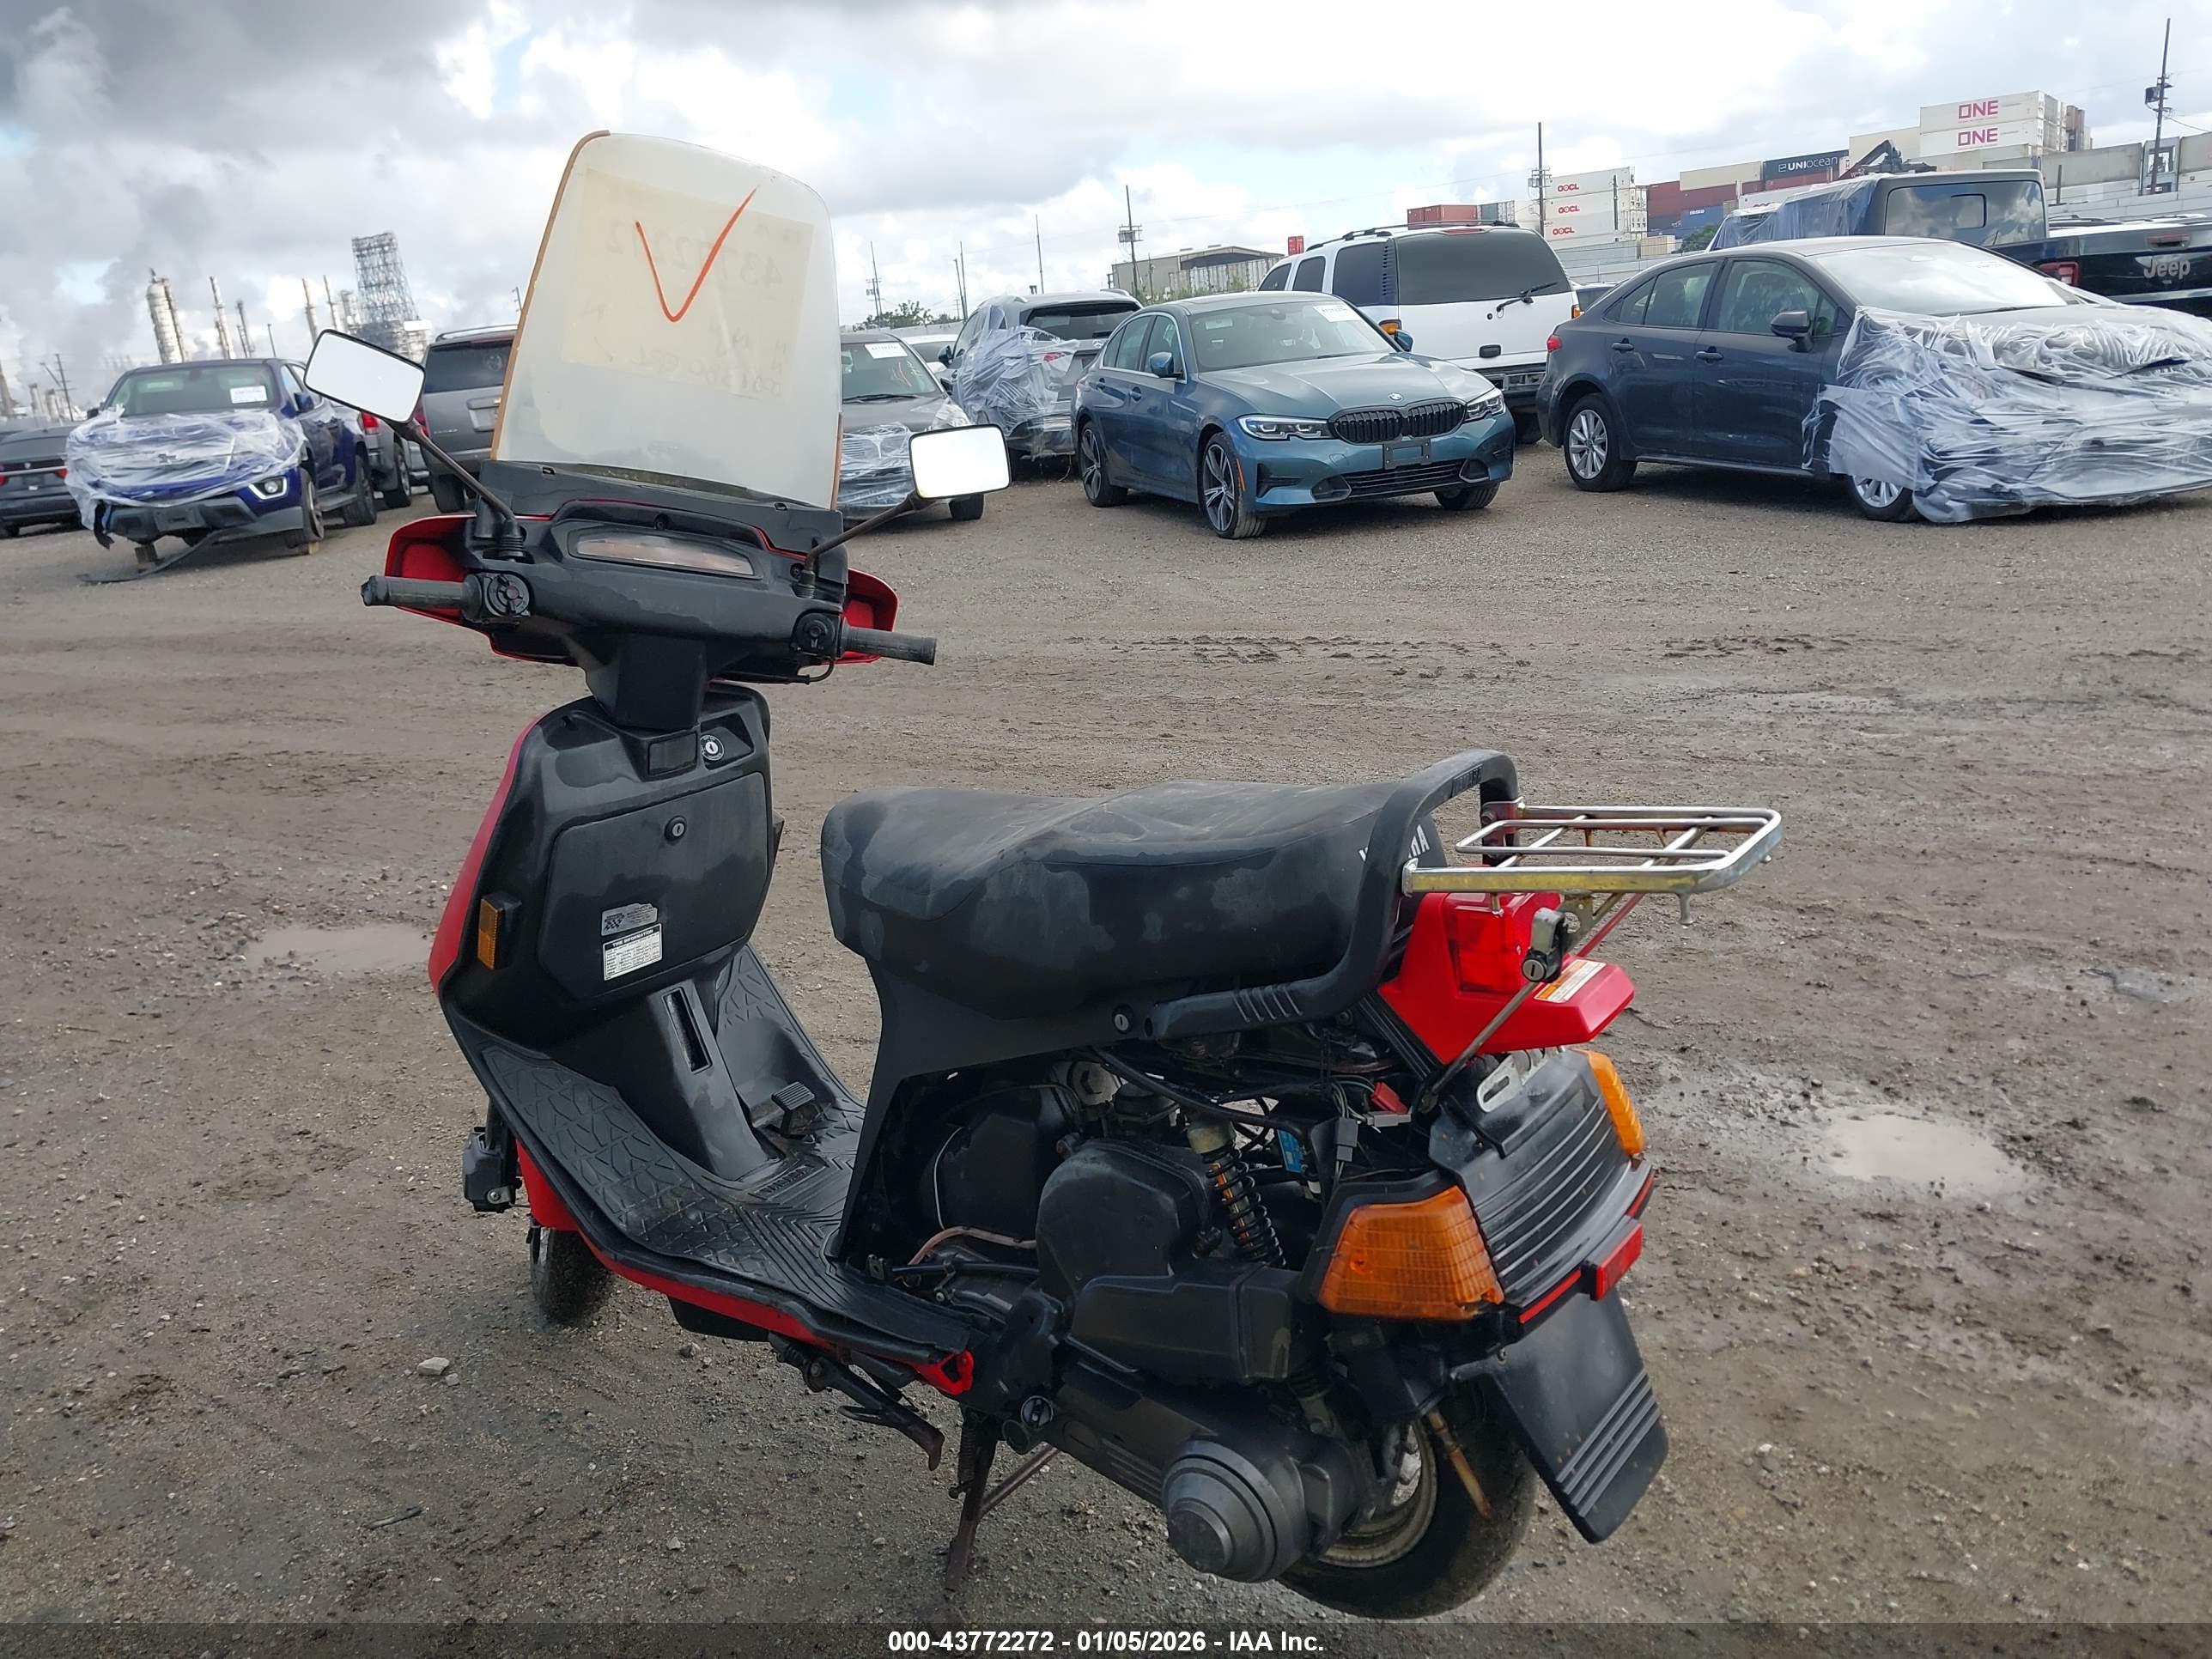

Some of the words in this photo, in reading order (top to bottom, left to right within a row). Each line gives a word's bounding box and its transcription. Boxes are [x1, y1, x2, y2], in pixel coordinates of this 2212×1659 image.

[1958, 100, 1999, 118] ONE
[1957, 127, 1998, 146] ONE
[1558, 205, 1580, 214] OOCL
[1553, 227, 1575, 235] OOCL
[2143, 257, 2191, 280] Jeep
